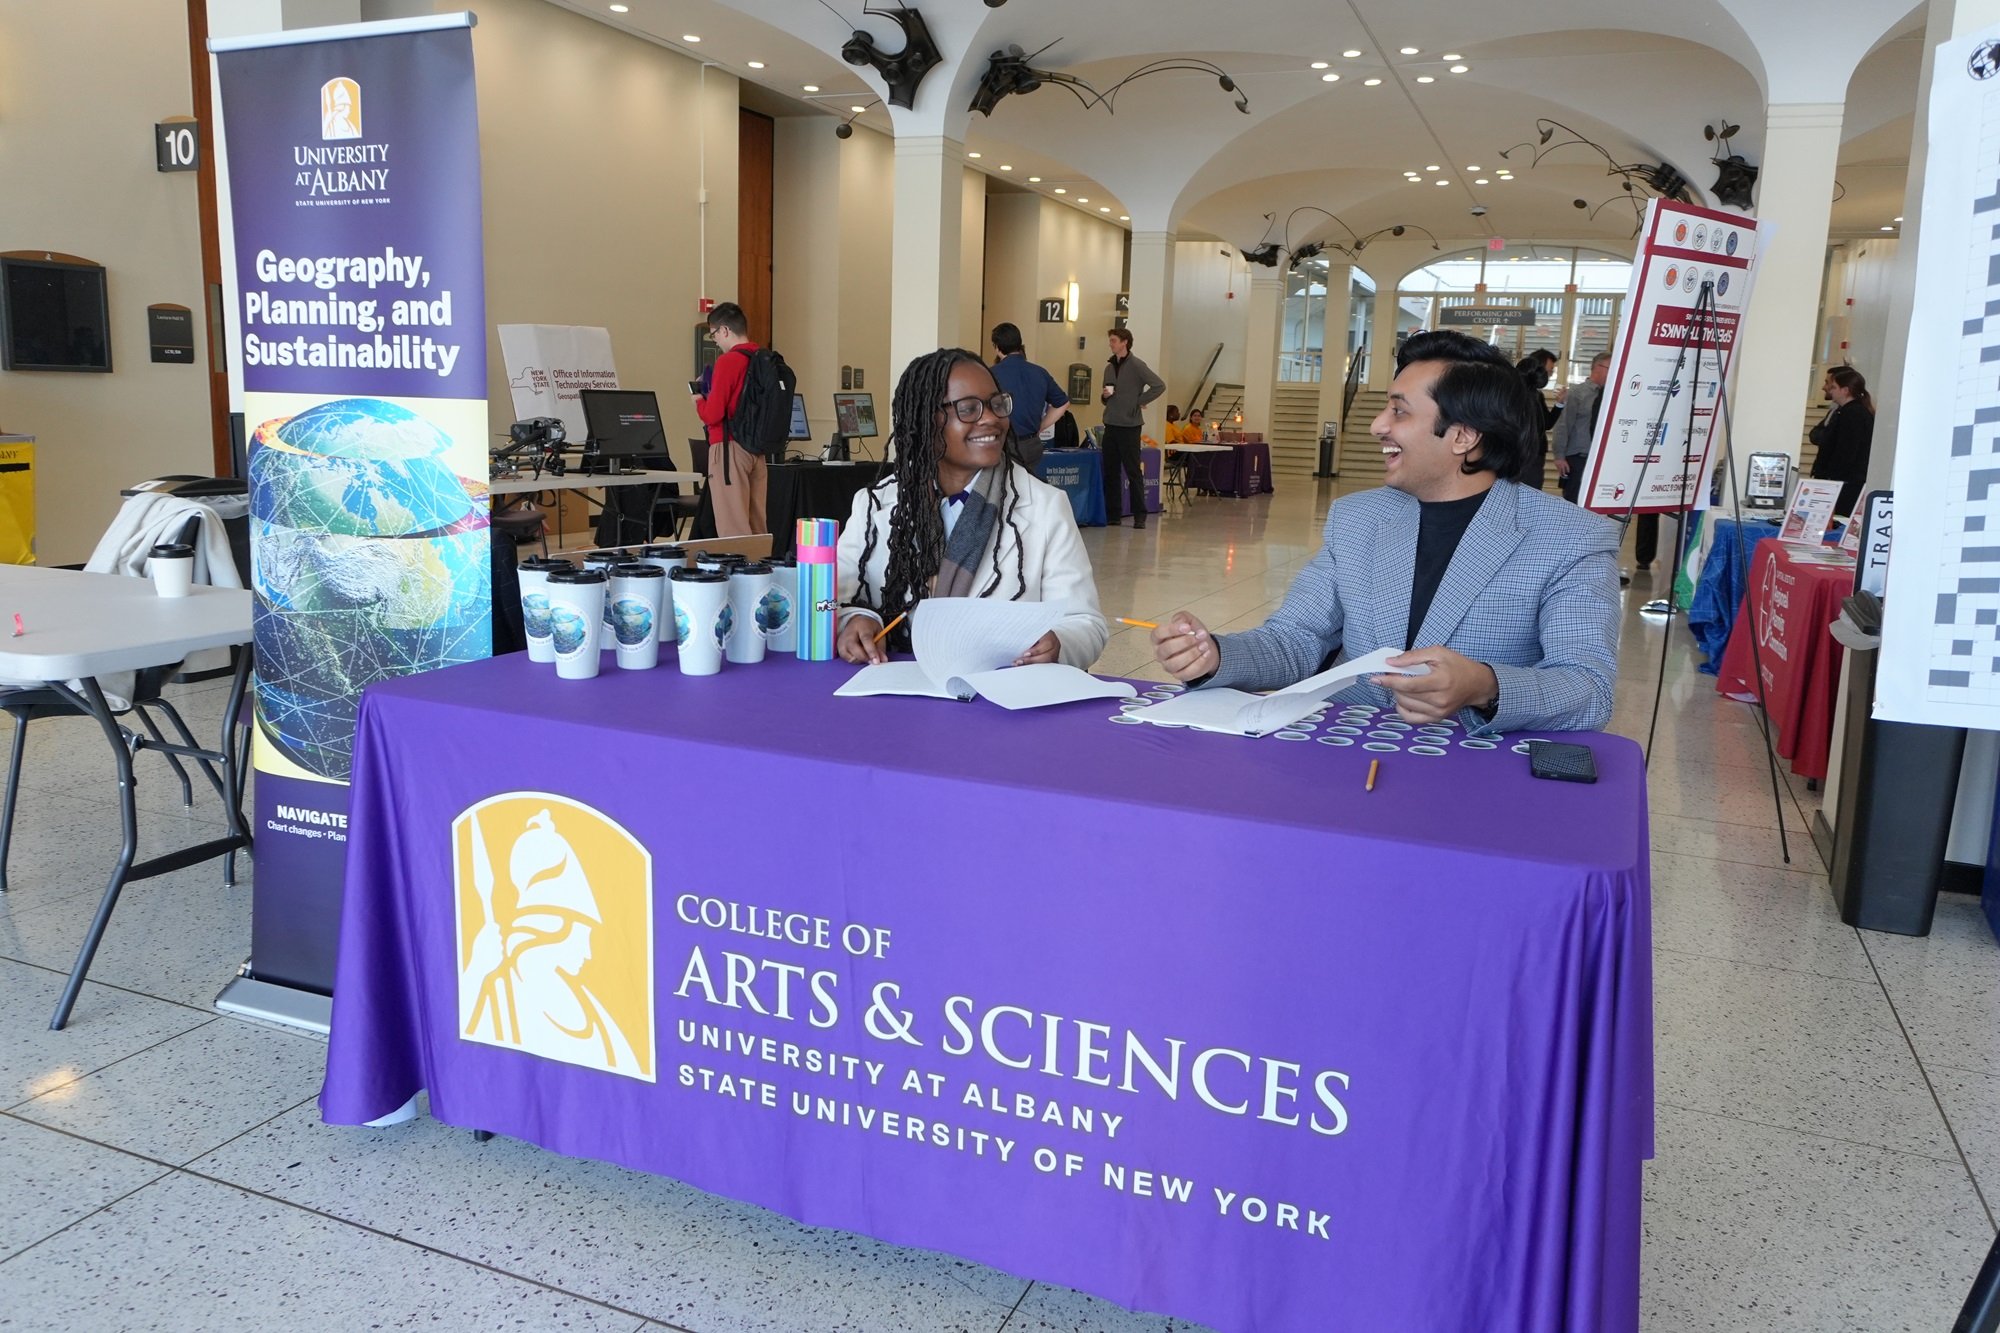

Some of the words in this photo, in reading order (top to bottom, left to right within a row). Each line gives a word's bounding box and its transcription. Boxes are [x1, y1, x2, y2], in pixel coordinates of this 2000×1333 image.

[165, 128, 195, 165] 10
[293, 143, 389, 166] UNIVERSITY
[295, 171, 312, 186] AT
[309, 167, 389, 196] ALBANY
[256, 246, 430, 290] Geography,
[245, 291, 385, 333] Planning,
[391, 290, 452, 326] and
[1045, 302, 1061, 321] 12
[1702, 328, 1733, 343] SPEIAL
[245, 333, 460, 377] Sustainability
[553, 369, 572, 379] Office
[573, 369, 580, 379] of
[581, 369, 615, 379] Information
[555, 380, 592, 390] Technology
[592, 381, 617, 389] Services
[1672, 474, 1697, 482] WORSHOP
[1674, 483, 1694, 492] PLANING
[1871, 495, 1894, 568] TRASH
[267, 820, 288, 832] Chart
[288, 825, 322, 838] changes
[277, 804, 348, 828] NAVIGATE
[676, 894, 831, 949] COLLEGE
[841, 924, 891, 959] OF
[673, 945, 839, 1028] ARTS
[863, 981, 924, 1047] &
[942, 995, 1350, 1136] SCIENCES
[678, 1019, 884, 1085] UNIVERSITY
[901, 1069, 946, 1097] AT
[962, 1083, 1123, 1138] ALBANY
[679, 1064, 777, 1107] STATE
[792, 1091, 1015, 1162] UNIVERSITY
[1033, 1148, 1084, 1177] OF
[1104, 1162, 1194, 1203] NEW
[1213, 1187, 1331, 1240] YORK
